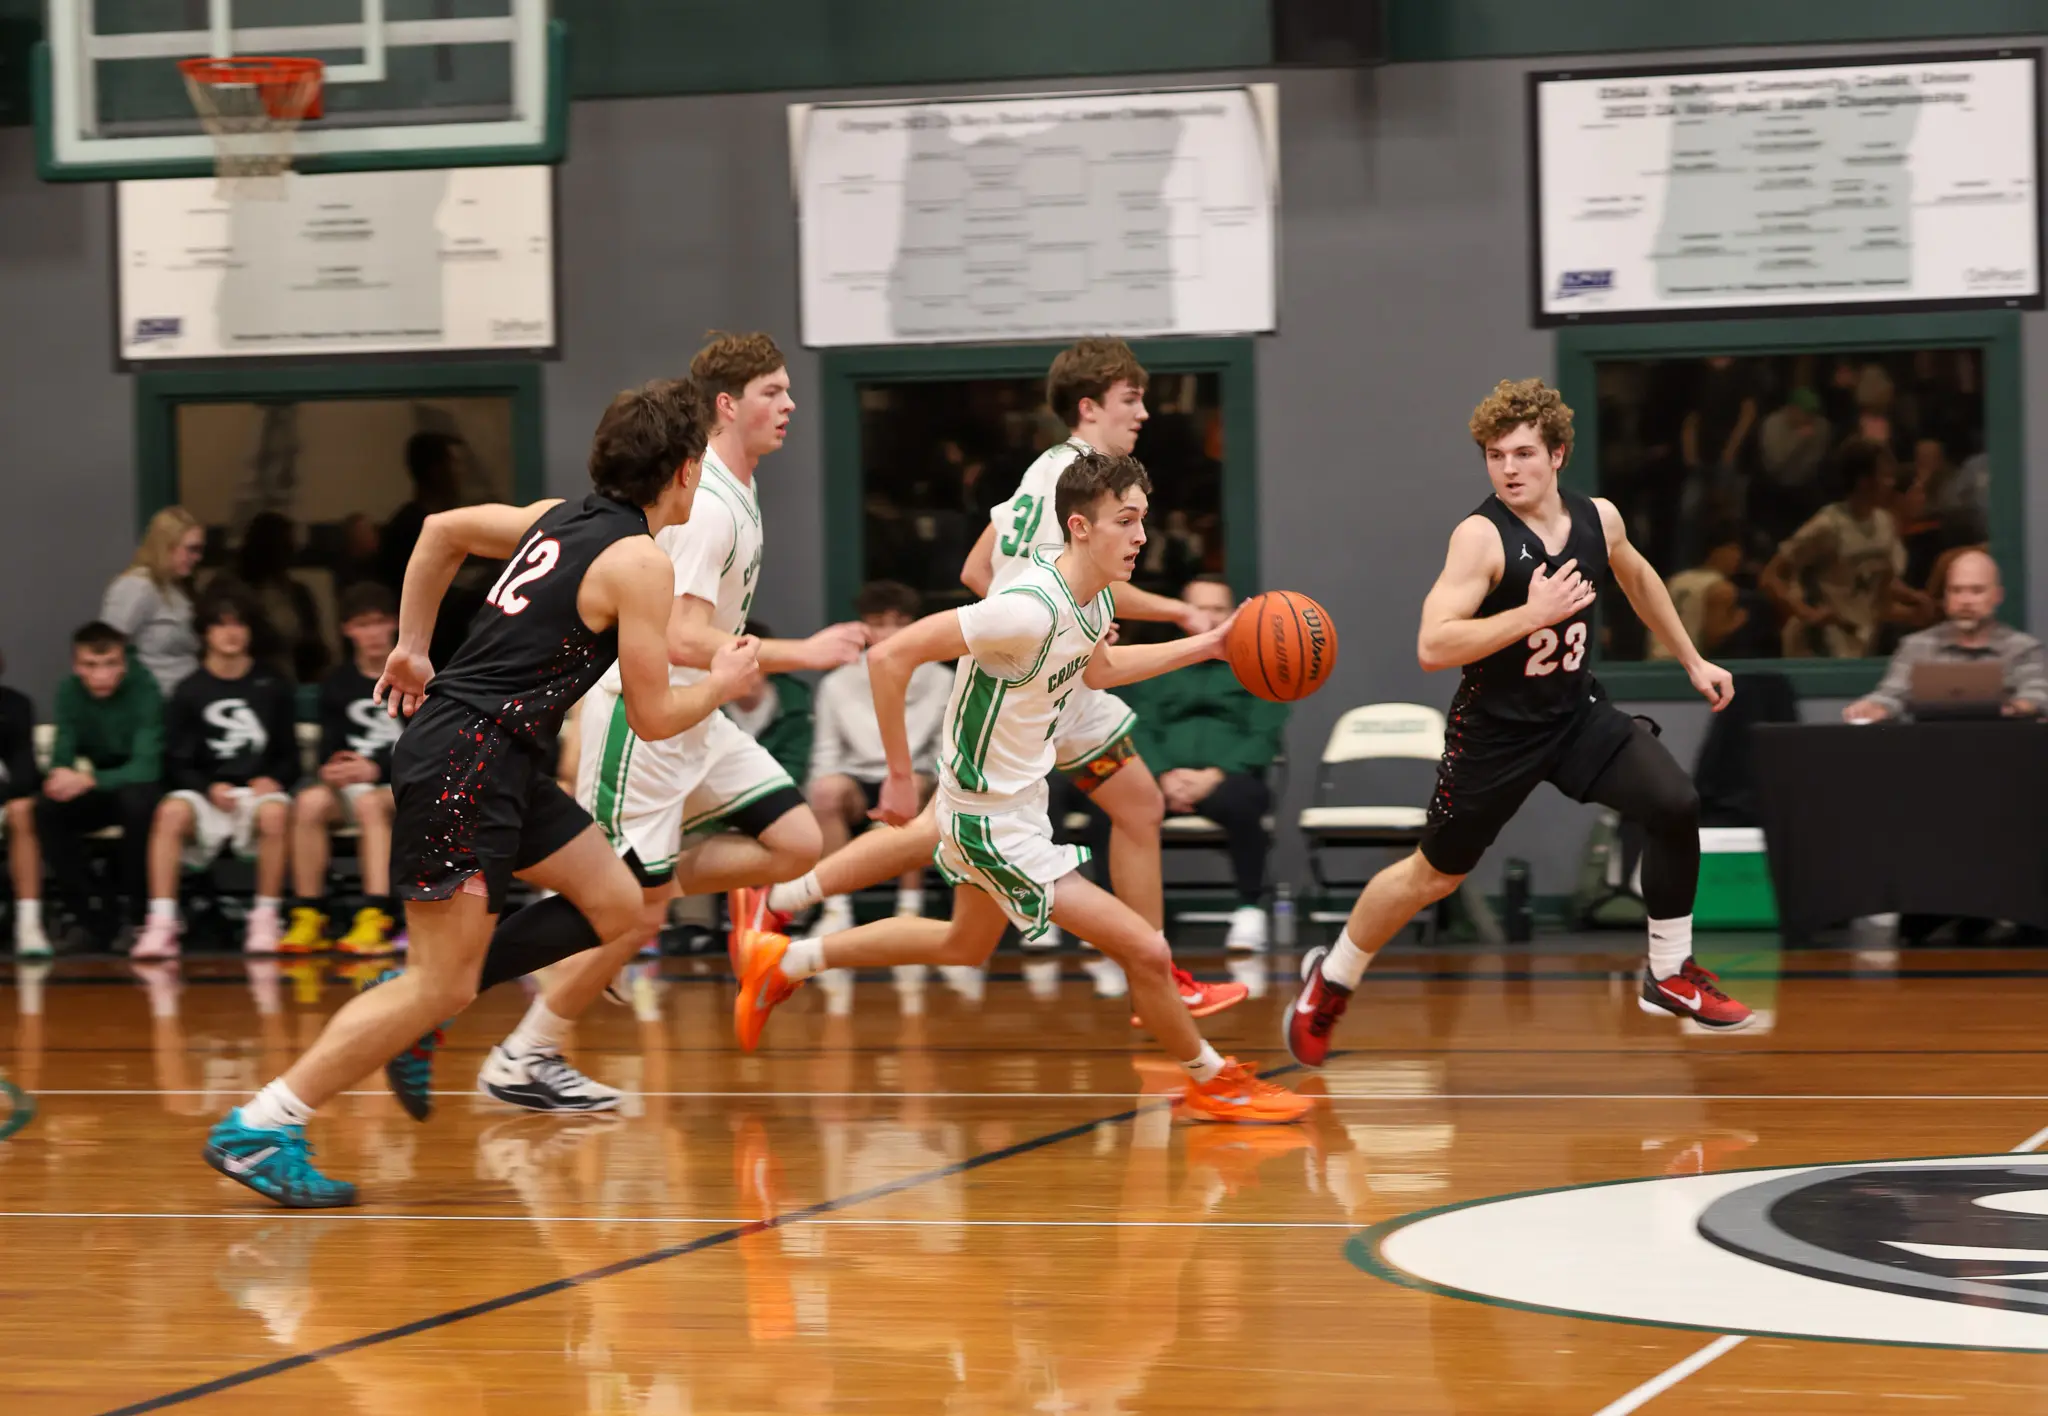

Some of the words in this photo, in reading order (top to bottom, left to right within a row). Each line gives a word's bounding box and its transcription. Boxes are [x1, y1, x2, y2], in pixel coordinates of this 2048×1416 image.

[486, 529, 561, 617] 12
[1047, 653, 1092, 694] CRUSA
[1302, 607, 1326, 682] Wilson
[1523, 620, 1588, 678] 23
